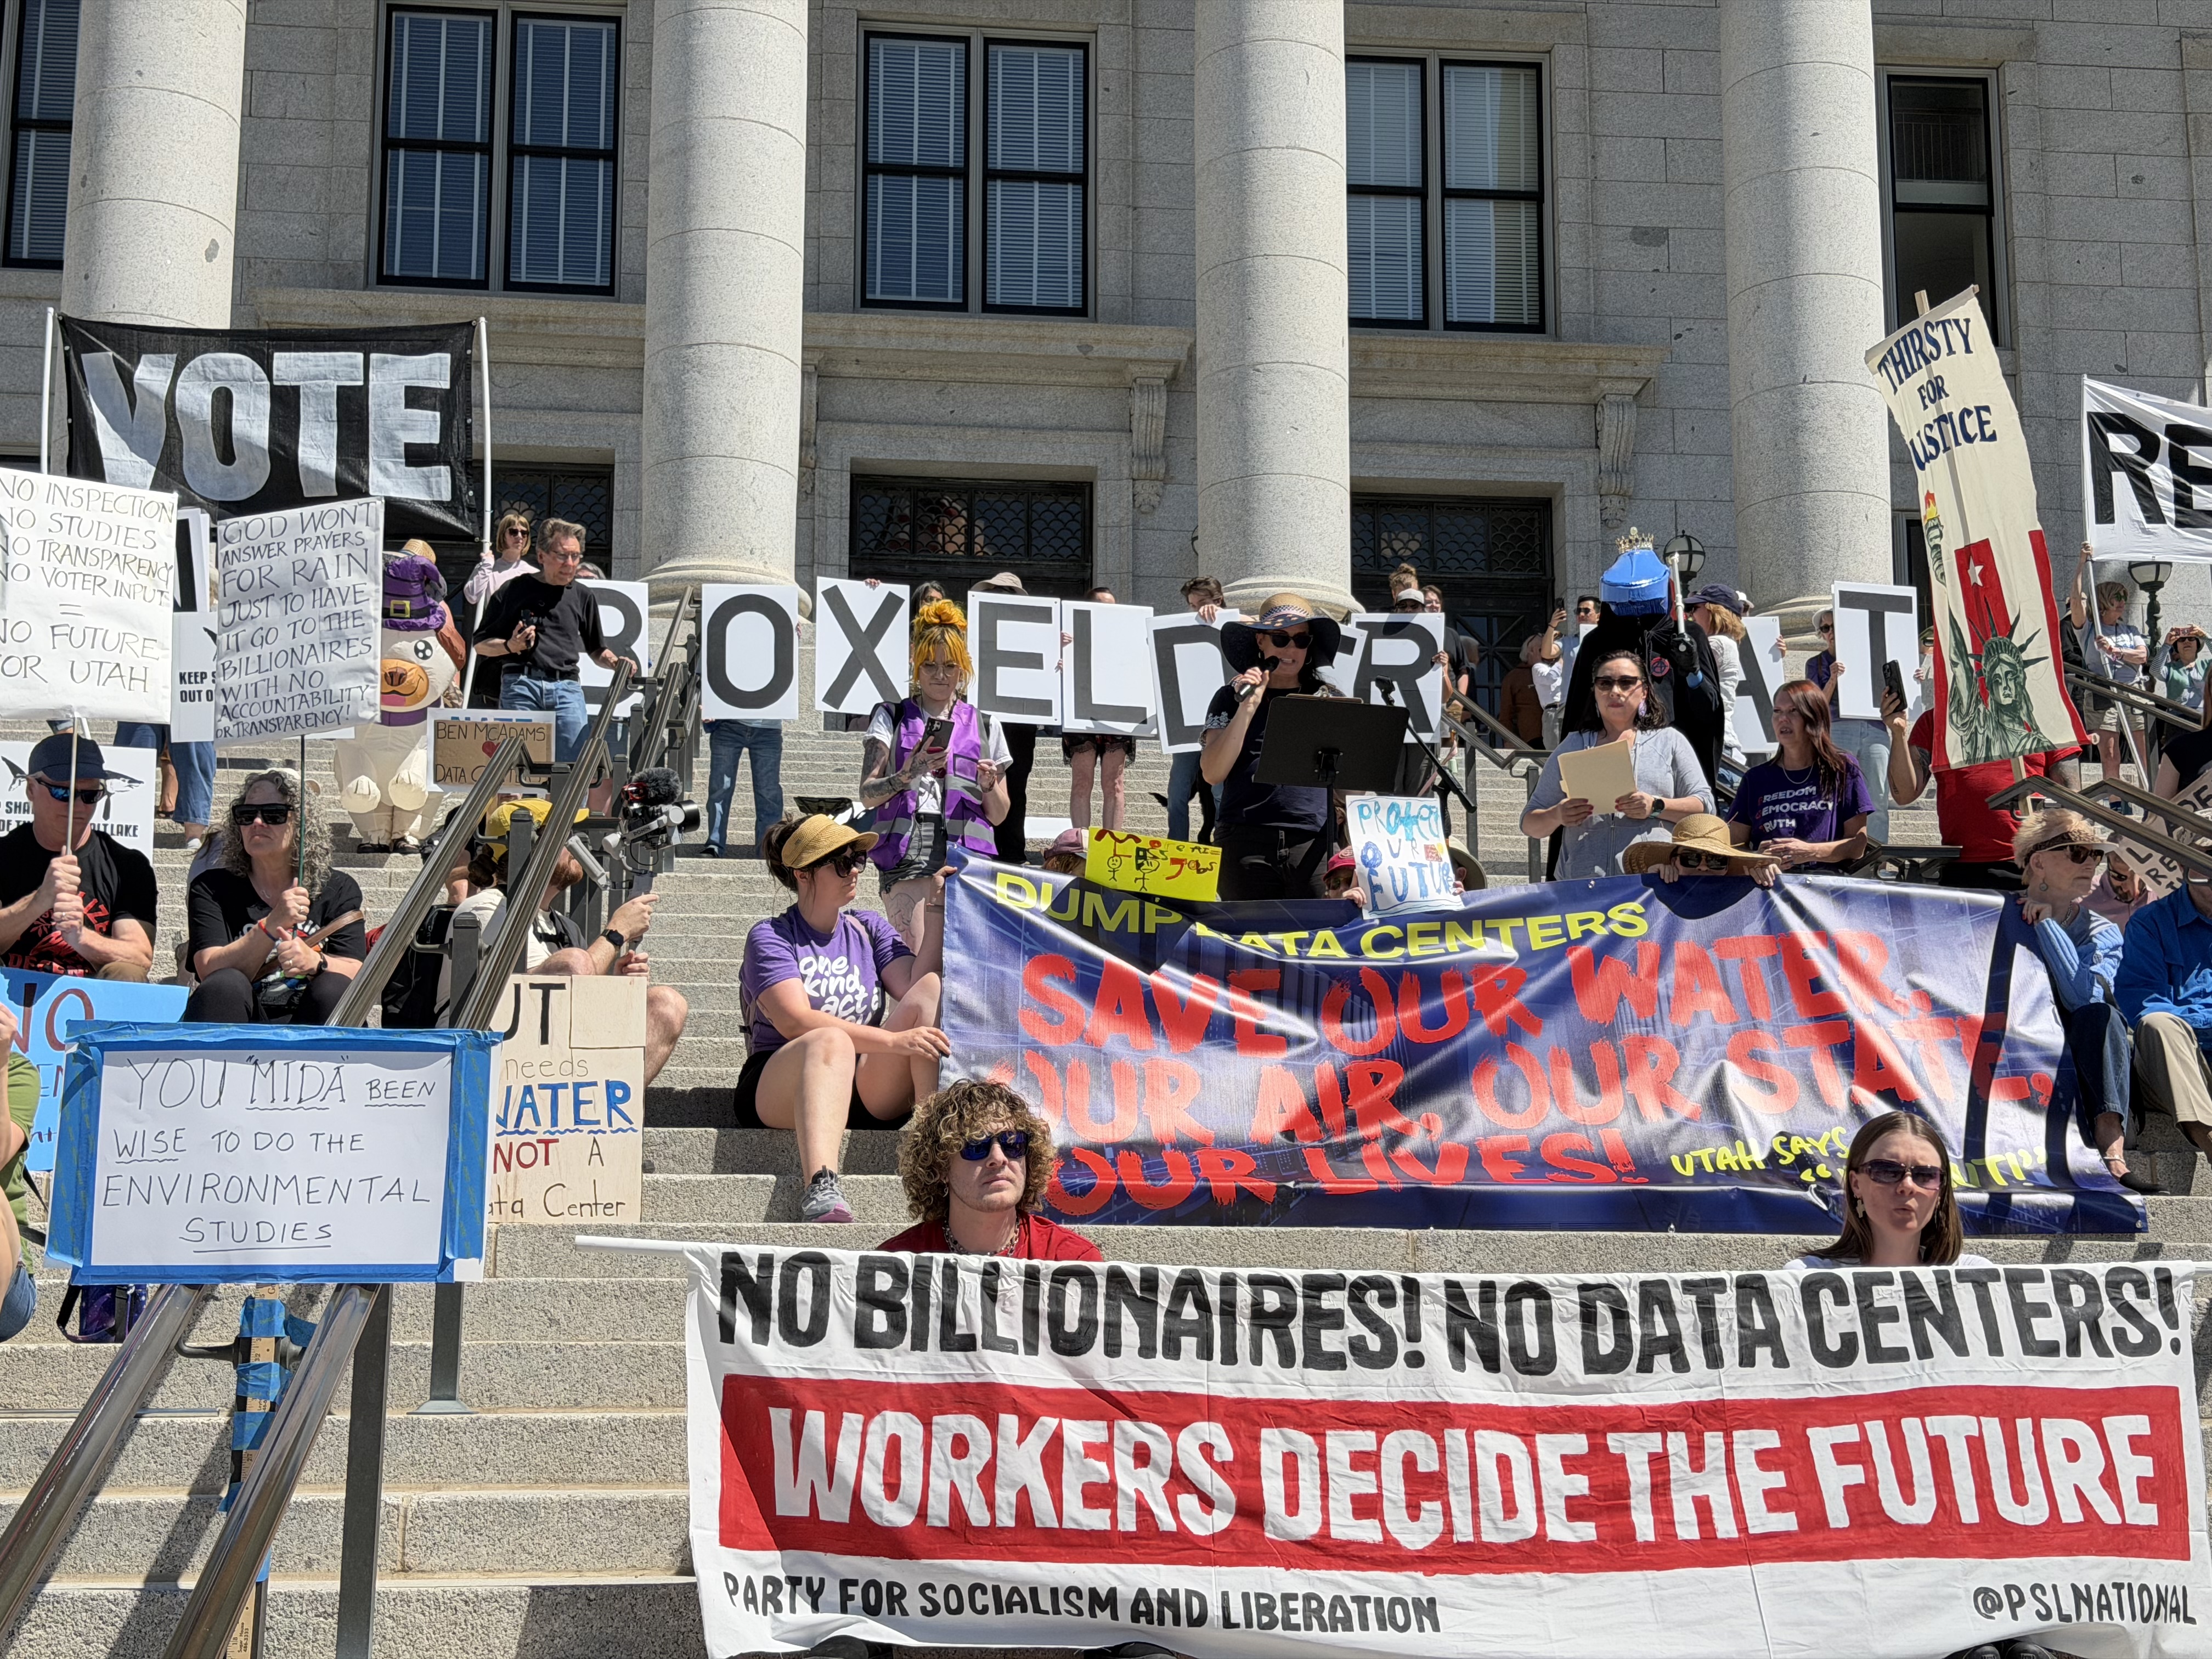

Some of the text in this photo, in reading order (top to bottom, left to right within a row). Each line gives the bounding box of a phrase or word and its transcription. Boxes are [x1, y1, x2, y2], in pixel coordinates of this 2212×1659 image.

[1877, 318, 1974, 396] THIRSTY
[1917, 374, 1950, 411] FOR
[81, 351, 452, 501] VOTE
[1909, 405, 1997, 471] USTICE
[0, 475, 174, 523] NO INSPECTION
[48, 512, 157, 550] STUDIES
[222, 531, 365, 568] ANSWER PRAYERS
[223, 516, 287, 545] GOD
[36, 538, 174, 590] TRANSPARENCY
[222, 548, 369, 597] FOR RAIN
[40, 566, 111, 598] VOTER
[113, 579, 170, 607] INPUT
[221, 582, 370, 628] JUST TO HAVE
[49, 623, 160, 661] FUTURE
[225, 608, 365, 653] IT GO TO THE
[0, 654, 149, 693] OR UTAH
[179, 671, 208, 685] KEEP
[221, 636, 372, 681] BILLIONAIRES
[978, 601, 1437, 746] ELDR
[179, 689, 204, 703] OUT
[217, 684, 370, 723] ACCOUNTABILITY
[221, 675, 278, 703] WITH
[288, 670, 324, 693] NO
[215, 704, 351, 739] OR TRANSPARENCY!
[437, 721, 468, 740] BEN
[435, 764, 467, 783] DATA
[110, 823, 138, 837] LAKE
[1360, 837, 1420, 868] OUR
[996, 871, 1183, 934] DUMP
[1359, 902, 1649, 959] CENTERS
[799, 955, 849, 975] one
[804, 964, 861, 997] kind
[820, 985, 868, 1019] act
[1018, 952, 1288, 1058] SAVE
[1321, 962, 1543, 1056] OUR
[127, 1057, 227, 1110] YOU
[365, 1078, 437, 1101] BEEN
[505, 1052, 589, 1080] needs
[1249, 1058, 1442, 1145] AIR,
[1471, 1034, 1701, 1129] OUR
[114, 1128, 365, 1158] WISE TO DO THE
[493, 1136, 605, 1175] NOT A
[1671, 1136, 1765, 1176] UTAH
[1771, 1126, 1851, 1165] SAYS
[103, 1172, 431, 1207] ENVIRONMENTAL
[1042, 1127, 1650, 1214] OUR LIVES!
[543, 1178, 626, 1218] Center
[178, 1217, 332, 1244] STUDIES
[719, 1251, 2182, 1376] NO BILLIONAIRES! NO DATA CENTERS!
[769, 1406, 2159, 1551] WORKERS DECIDE THE FUTURE
[723, 1571, 1442, 1633] PARTY FOR SOCIALISM AND LIBERATION
[1973, 1582, 2197, 1626] @PSLNATIONAL
